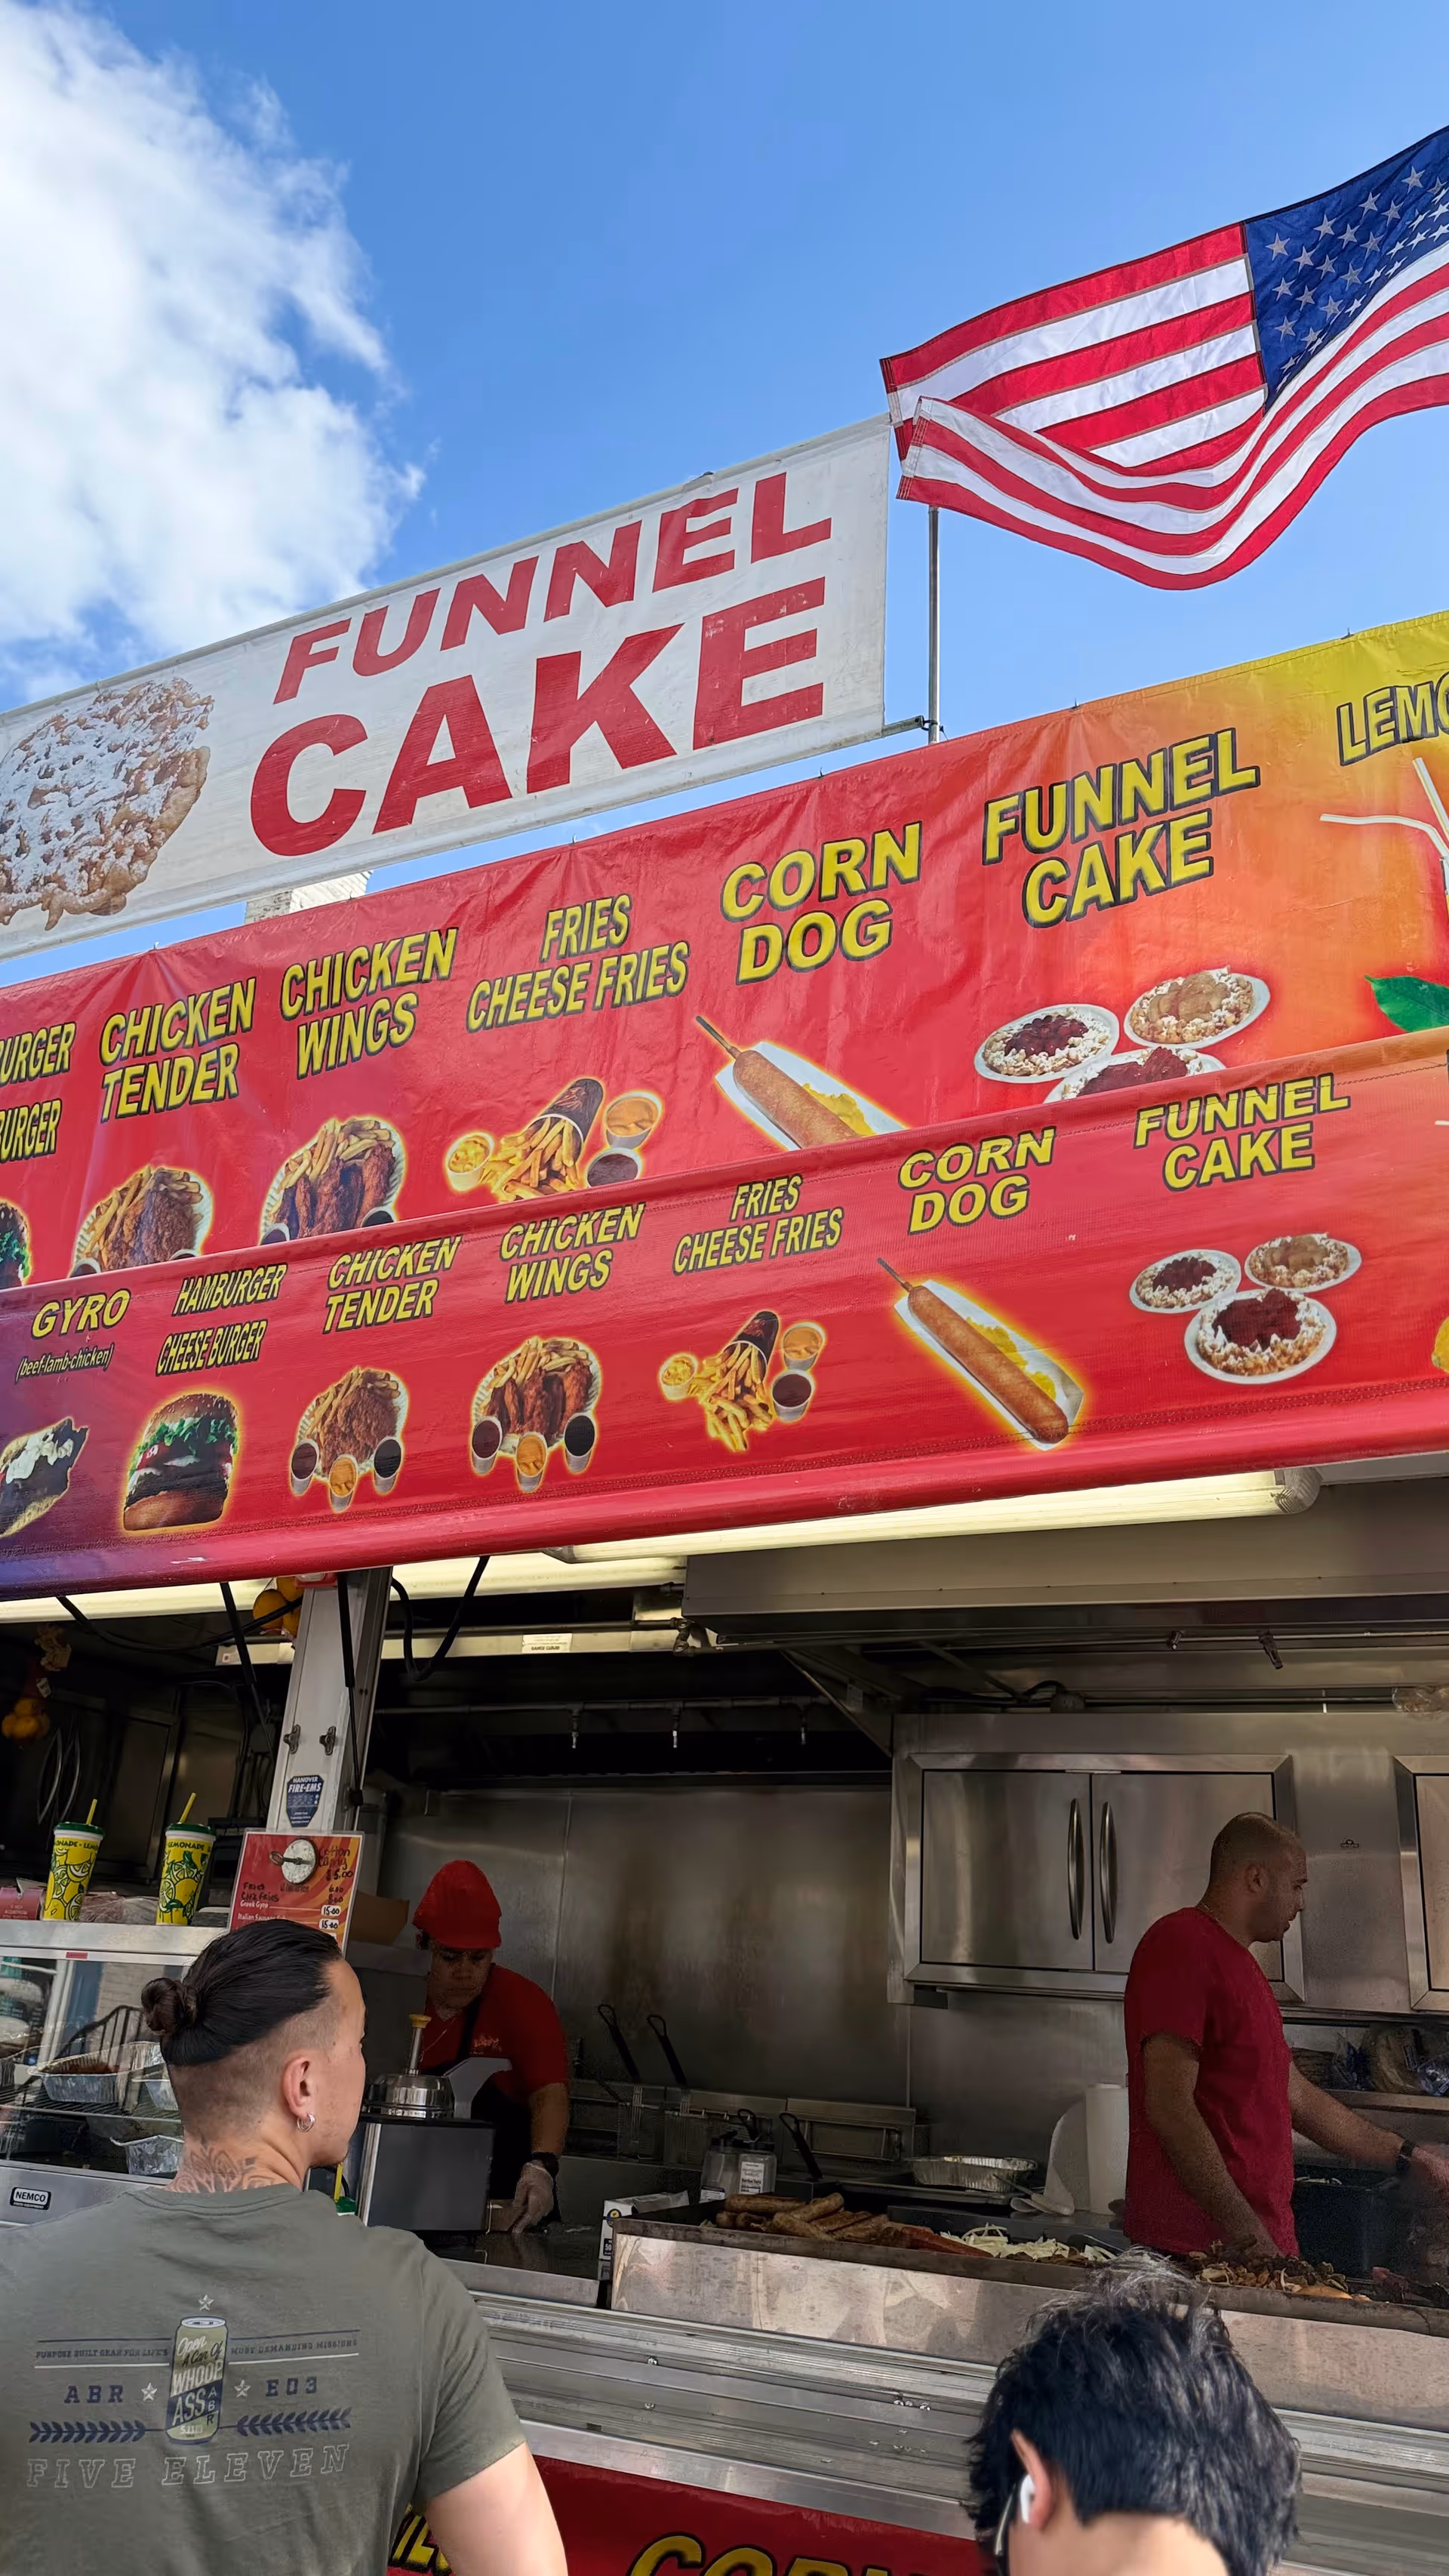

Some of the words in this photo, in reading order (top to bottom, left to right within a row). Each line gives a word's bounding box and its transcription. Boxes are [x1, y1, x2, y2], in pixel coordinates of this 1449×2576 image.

[273, 472, 832, 705] FUNNEL
[251, 577, 826, 856] CAKE
[983, 728, 1260, 866] FUNNEL
[721, 820, 922, 922] CORN
[1023, 808, 1214, 928] CAKE
[540, 894, 632, 962] FRIES
[736, 898, 893, 985] DOG
[280, 927, 458, 1021] CHICKEN
[466, 960, 595, 1033] CHEESE
[592, 940, 690, 1010] FRIES
[99, 978, 257, 1066] CHICKEN
[297, 992, 419, 1079] WINGS
[0, 1021, 76, 1088] URGER
[101, 1044, 239, 1123] TENDER
[1132, 1073, 1351, 1148] FUNNEL
[898, 1127, 1055, 1191] CORN
[1162, 1121, 1315, 1191] CAKE
[729, 1173, 803, 1223] FRIES
[909, 1174, 1029, 1235] DOG
[499, 1202, 646, 1261] CHICKEN
[672, 1220, 770, 1276] CHEESE
[770, 1207, 844, 1258] FRIES
[172, 1263, 288, 1316] HAMBURGER
[328, 1236, 463, 1291] CHICKEN
[505, 1249, 614, 1303] WINGS
[31, 1288, 131, 1340] GYRO
[322, 1279, 438, 1334] TENDER
[15, 1343, 115, 1383] (beef-lamb-chicken)
[155, 1327, 214, 1376] CHEESE
[205, 1320, 268, 1368] BURGER
[168, 1842, 205, 1851] LEMONADE
[238, 1913, 254, 1921] Italian
[240, 1900, 256, 1908] Greek
[256, 1901, 269, 1910] Gyro
[15, 2191, 46, 2202] NEMCO
[171, 2359, 224, 2397] WHOOP
[171, 2388, 206, 2427] ASS
[26, 2458, 137, 2488] FIVE
[162, 2443, 350, 2486] ELEVEN
